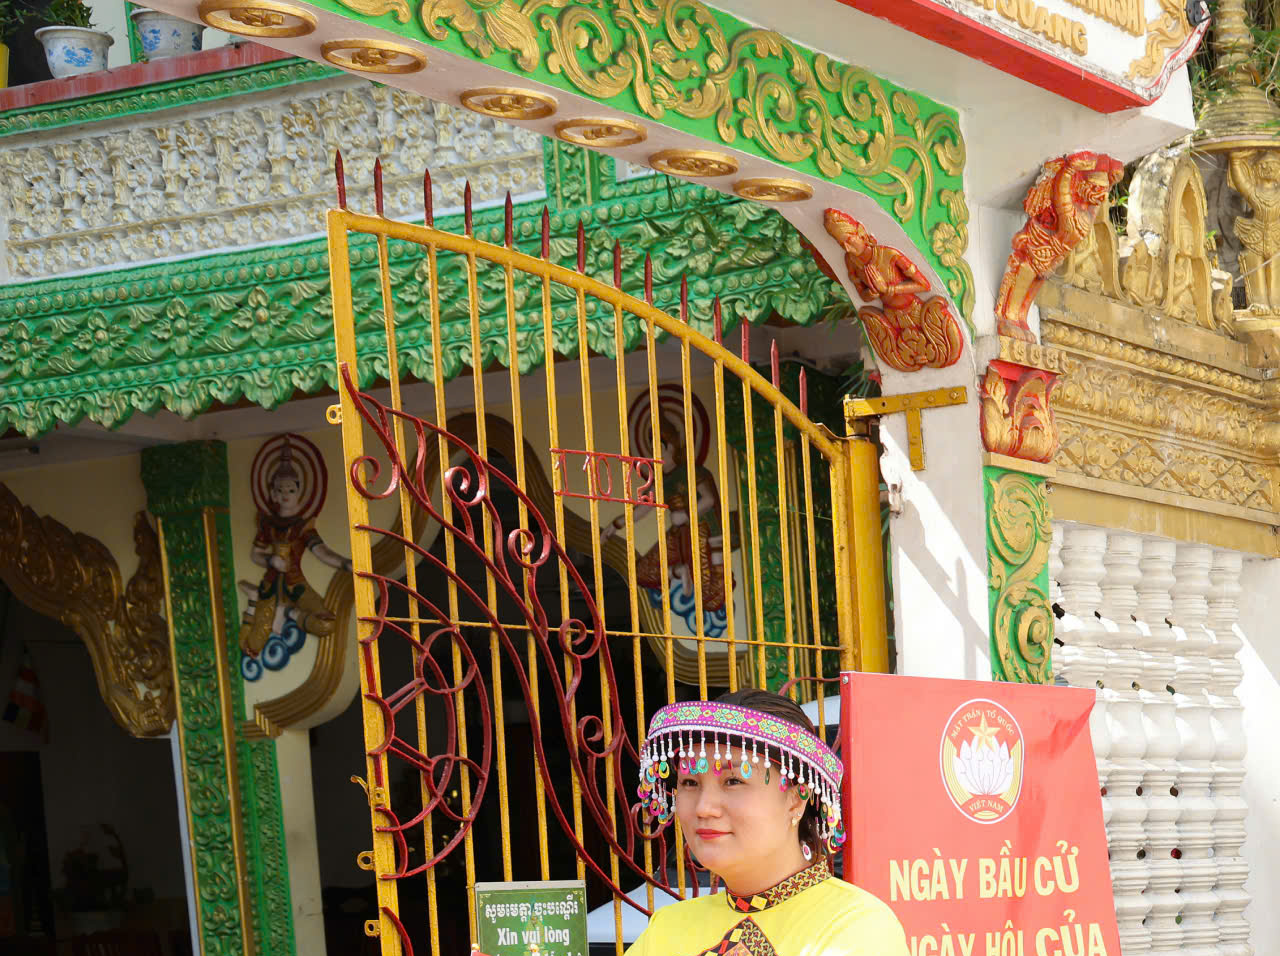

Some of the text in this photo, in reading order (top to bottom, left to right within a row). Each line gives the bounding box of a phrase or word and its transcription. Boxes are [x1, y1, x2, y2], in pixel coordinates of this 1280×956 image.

[987, 799, 1004, 813] NAM
[889, 840, 1080, 902] NGÀY BẦU CỬ
[497, 925, 570, 946] Xin vui lòng
